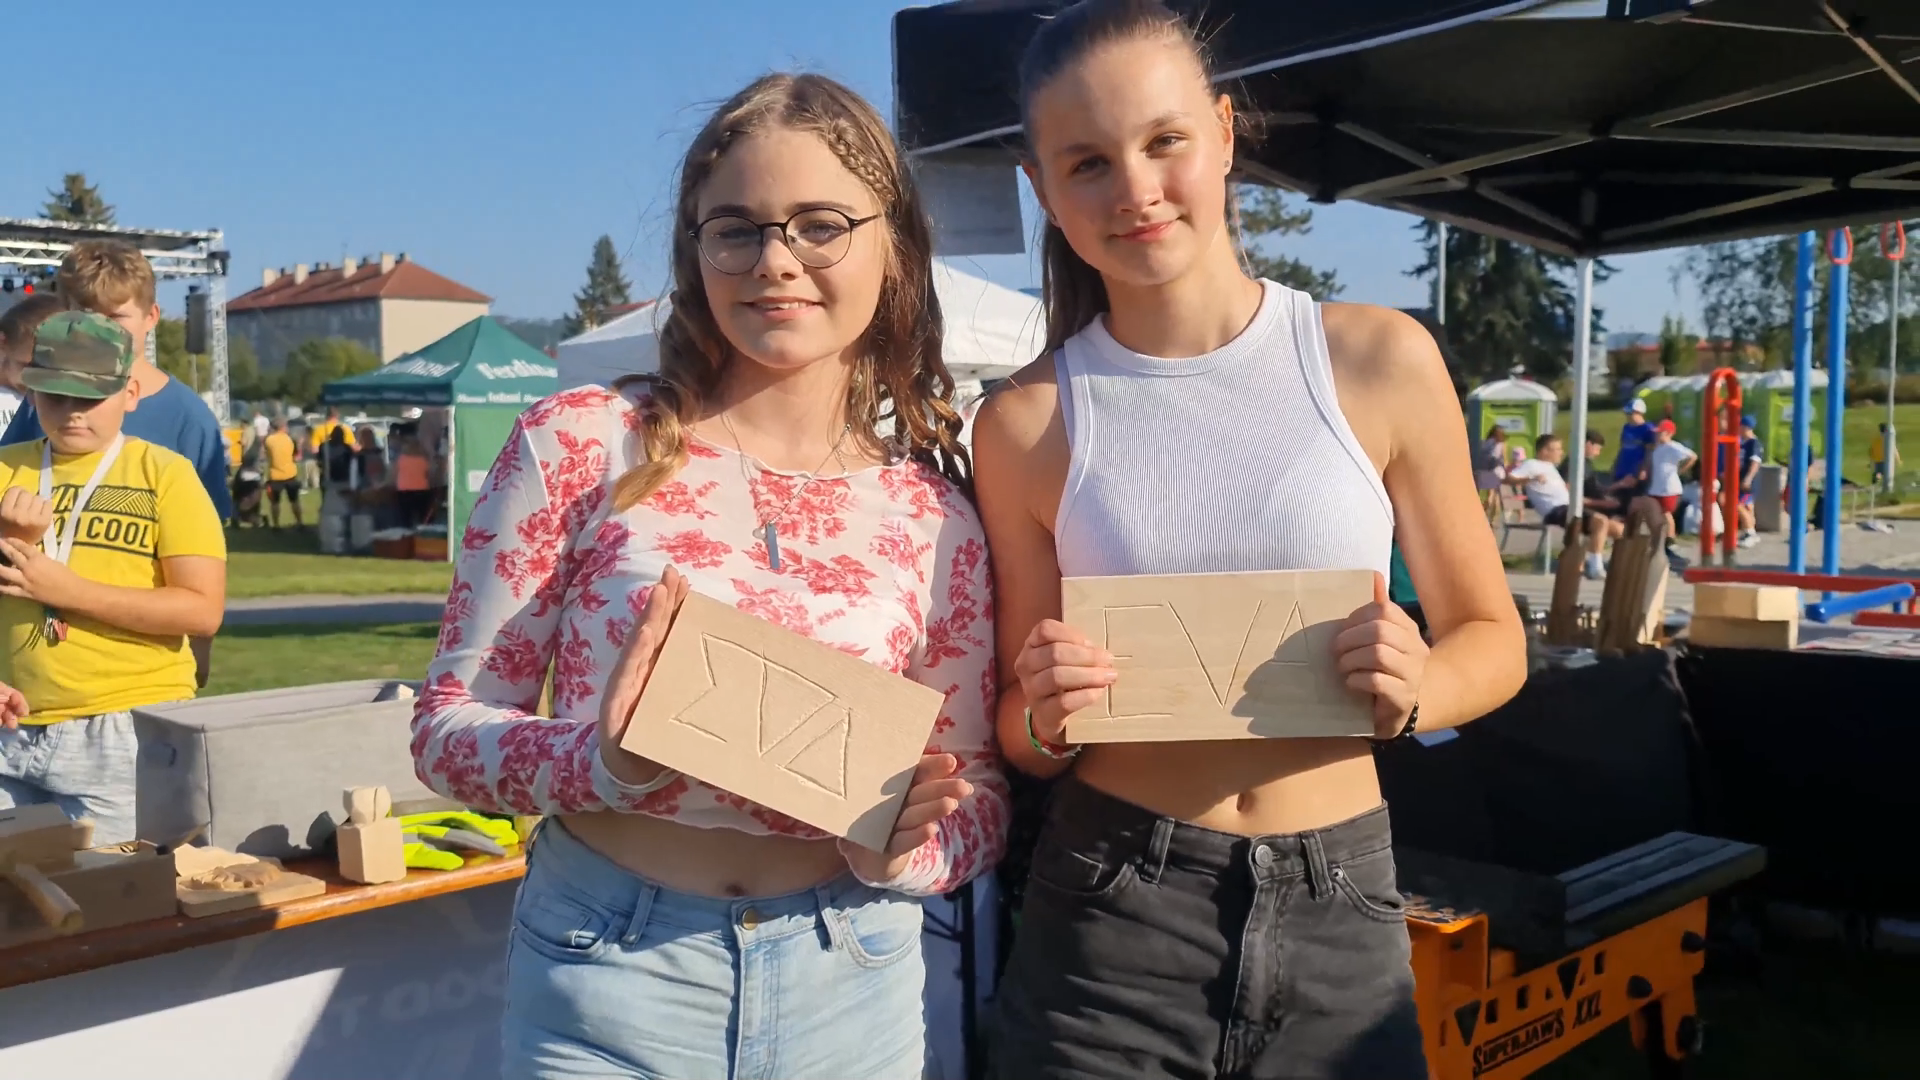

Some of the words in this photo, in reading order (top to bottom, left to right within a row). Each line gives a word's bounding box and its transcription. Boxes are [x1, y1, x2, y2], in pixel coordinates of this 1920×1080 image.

[86, 515, 149, 549] COOL
[1101, 598, 1312, 723] EVA
[1572, 990, 1602, 1030] XXL
